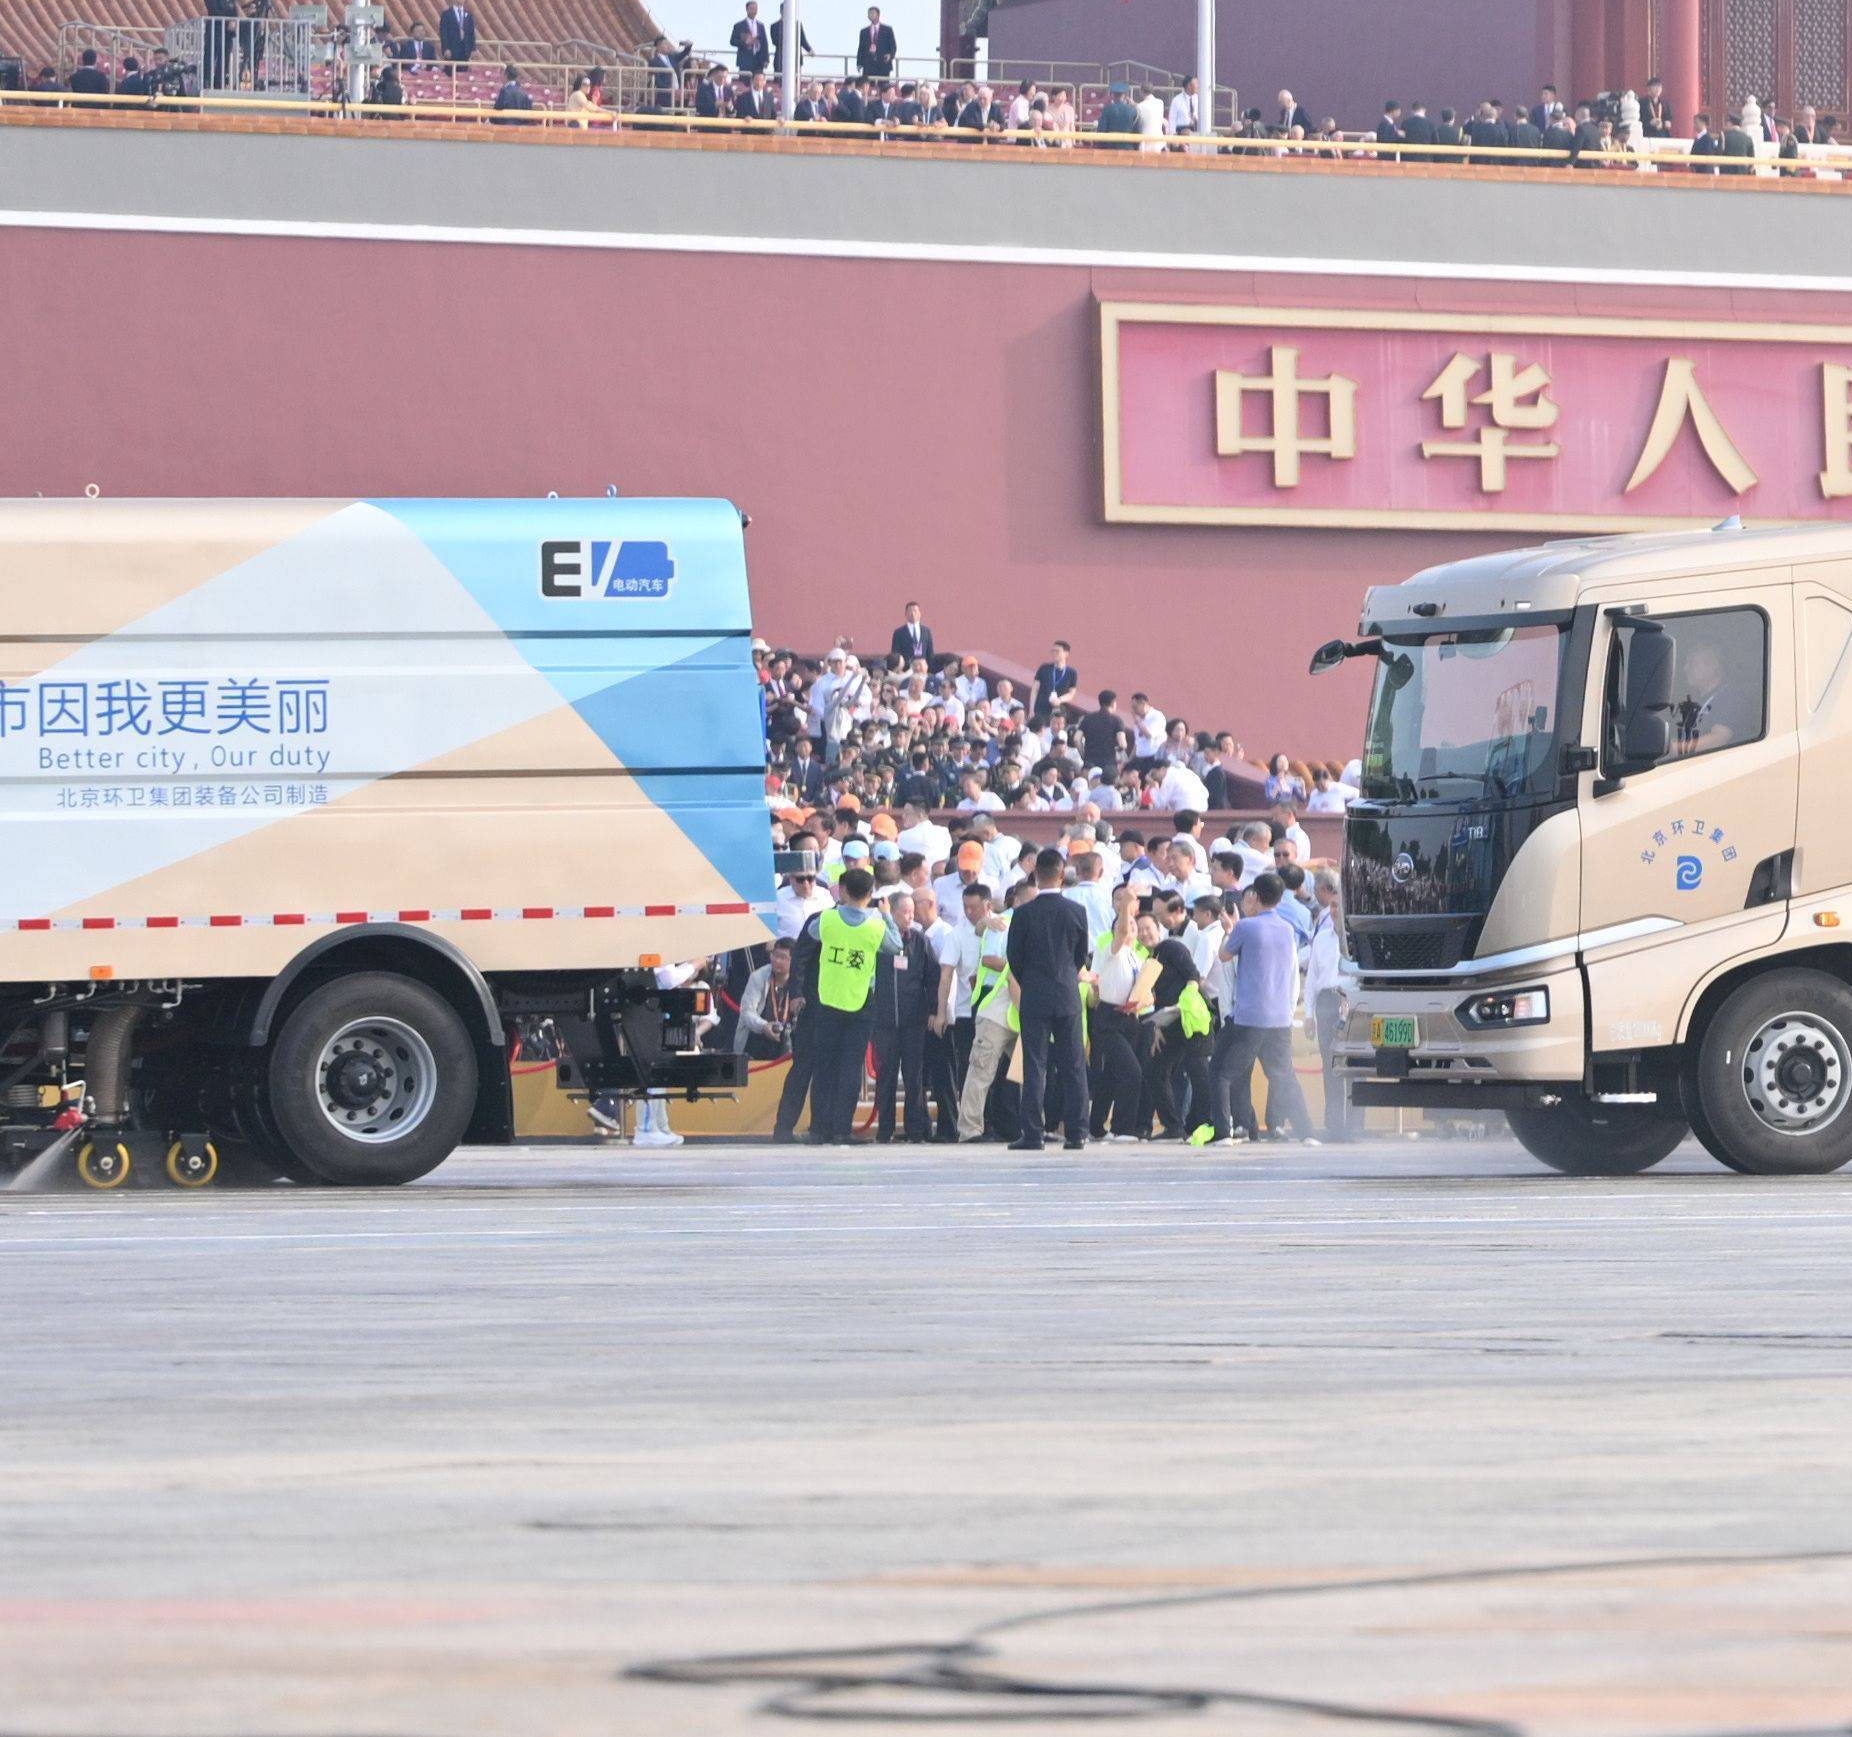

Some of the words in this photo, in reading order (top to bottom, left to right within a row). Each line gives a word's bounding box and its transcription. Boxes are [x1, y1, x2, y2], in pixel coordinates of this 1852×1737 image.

[541, 541, 623, 597] EV
[613, 578, 664, 592] 电动汽车
[39, 747, 125, 770] Better
[211, 745, 257, 767] Our
[269, 743, 331, 774] duty
[57, 784, 329, 808] 北京环卫集团装备公司制造
[1640, 819, 1738, 864] 北京环卫集团
